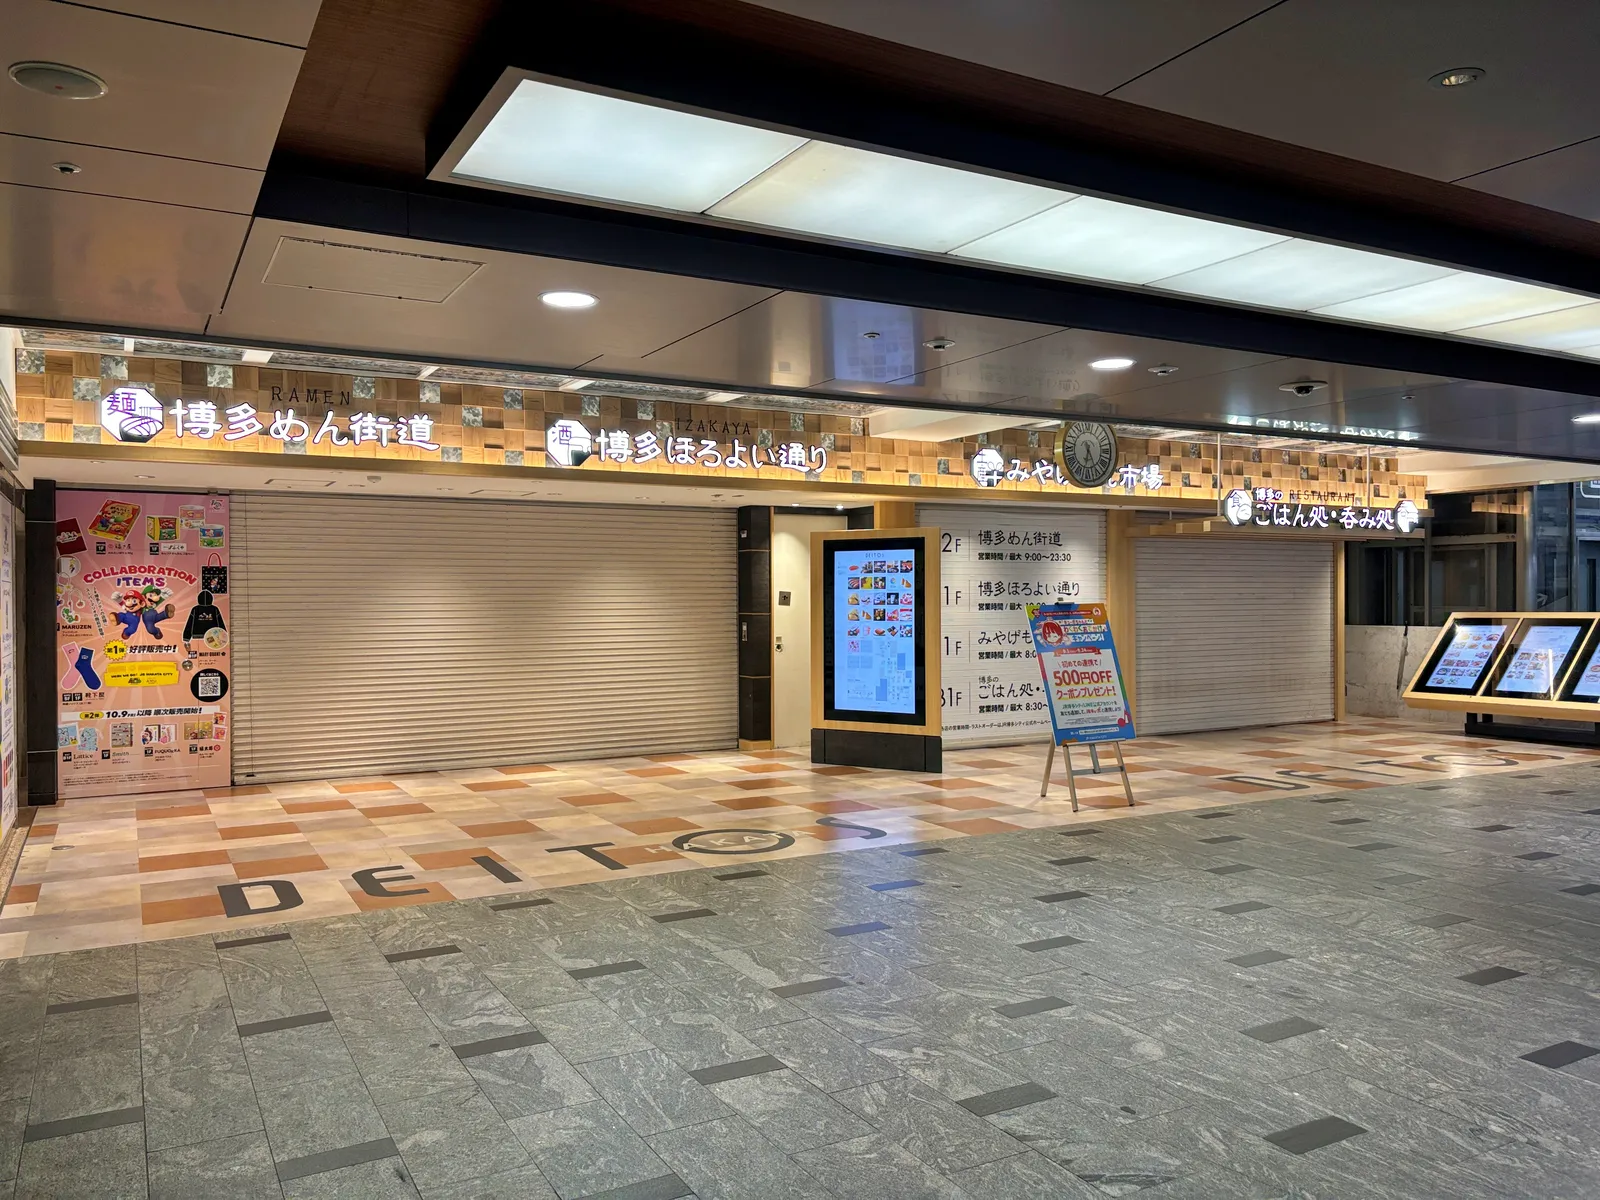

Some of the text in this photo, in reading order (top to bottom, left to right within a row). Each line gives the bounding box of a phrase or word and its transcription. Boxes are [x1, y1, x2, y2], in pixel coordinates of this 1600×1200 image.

[271, 386, 351, 404] RAMEN
[169, 398, 440, 452] 博多めん街道
[551, 424, 573, 444] 酒
[675, 417, 751, 436] IZAKAYA
[595, 428, 827, 474] 博多ほろよい通り
[1254, 487, 1284, 501] 博多の
[1289, 489, 1357, 503] RESTAURANT
[1255, 503, 1394, 530] ごはん処・呑み処
[942, 532, 962, 552] 2F
[978, 530, 1063, 547] 博多めん街道
[83, 566, 197, 585] COLLABORATION
[116, 577, 166, 587] ITEMS
[944, 586, 962, 605] 1F
[978, 580, 1080, 597] 博多ほろよい通り
[944, 636, 962, 656] 1F
[978, 676, 999, 684] 博多の
[1053, 670, 1112, 686] 500円OFF
[106, 710, 128, 718] 10.9
